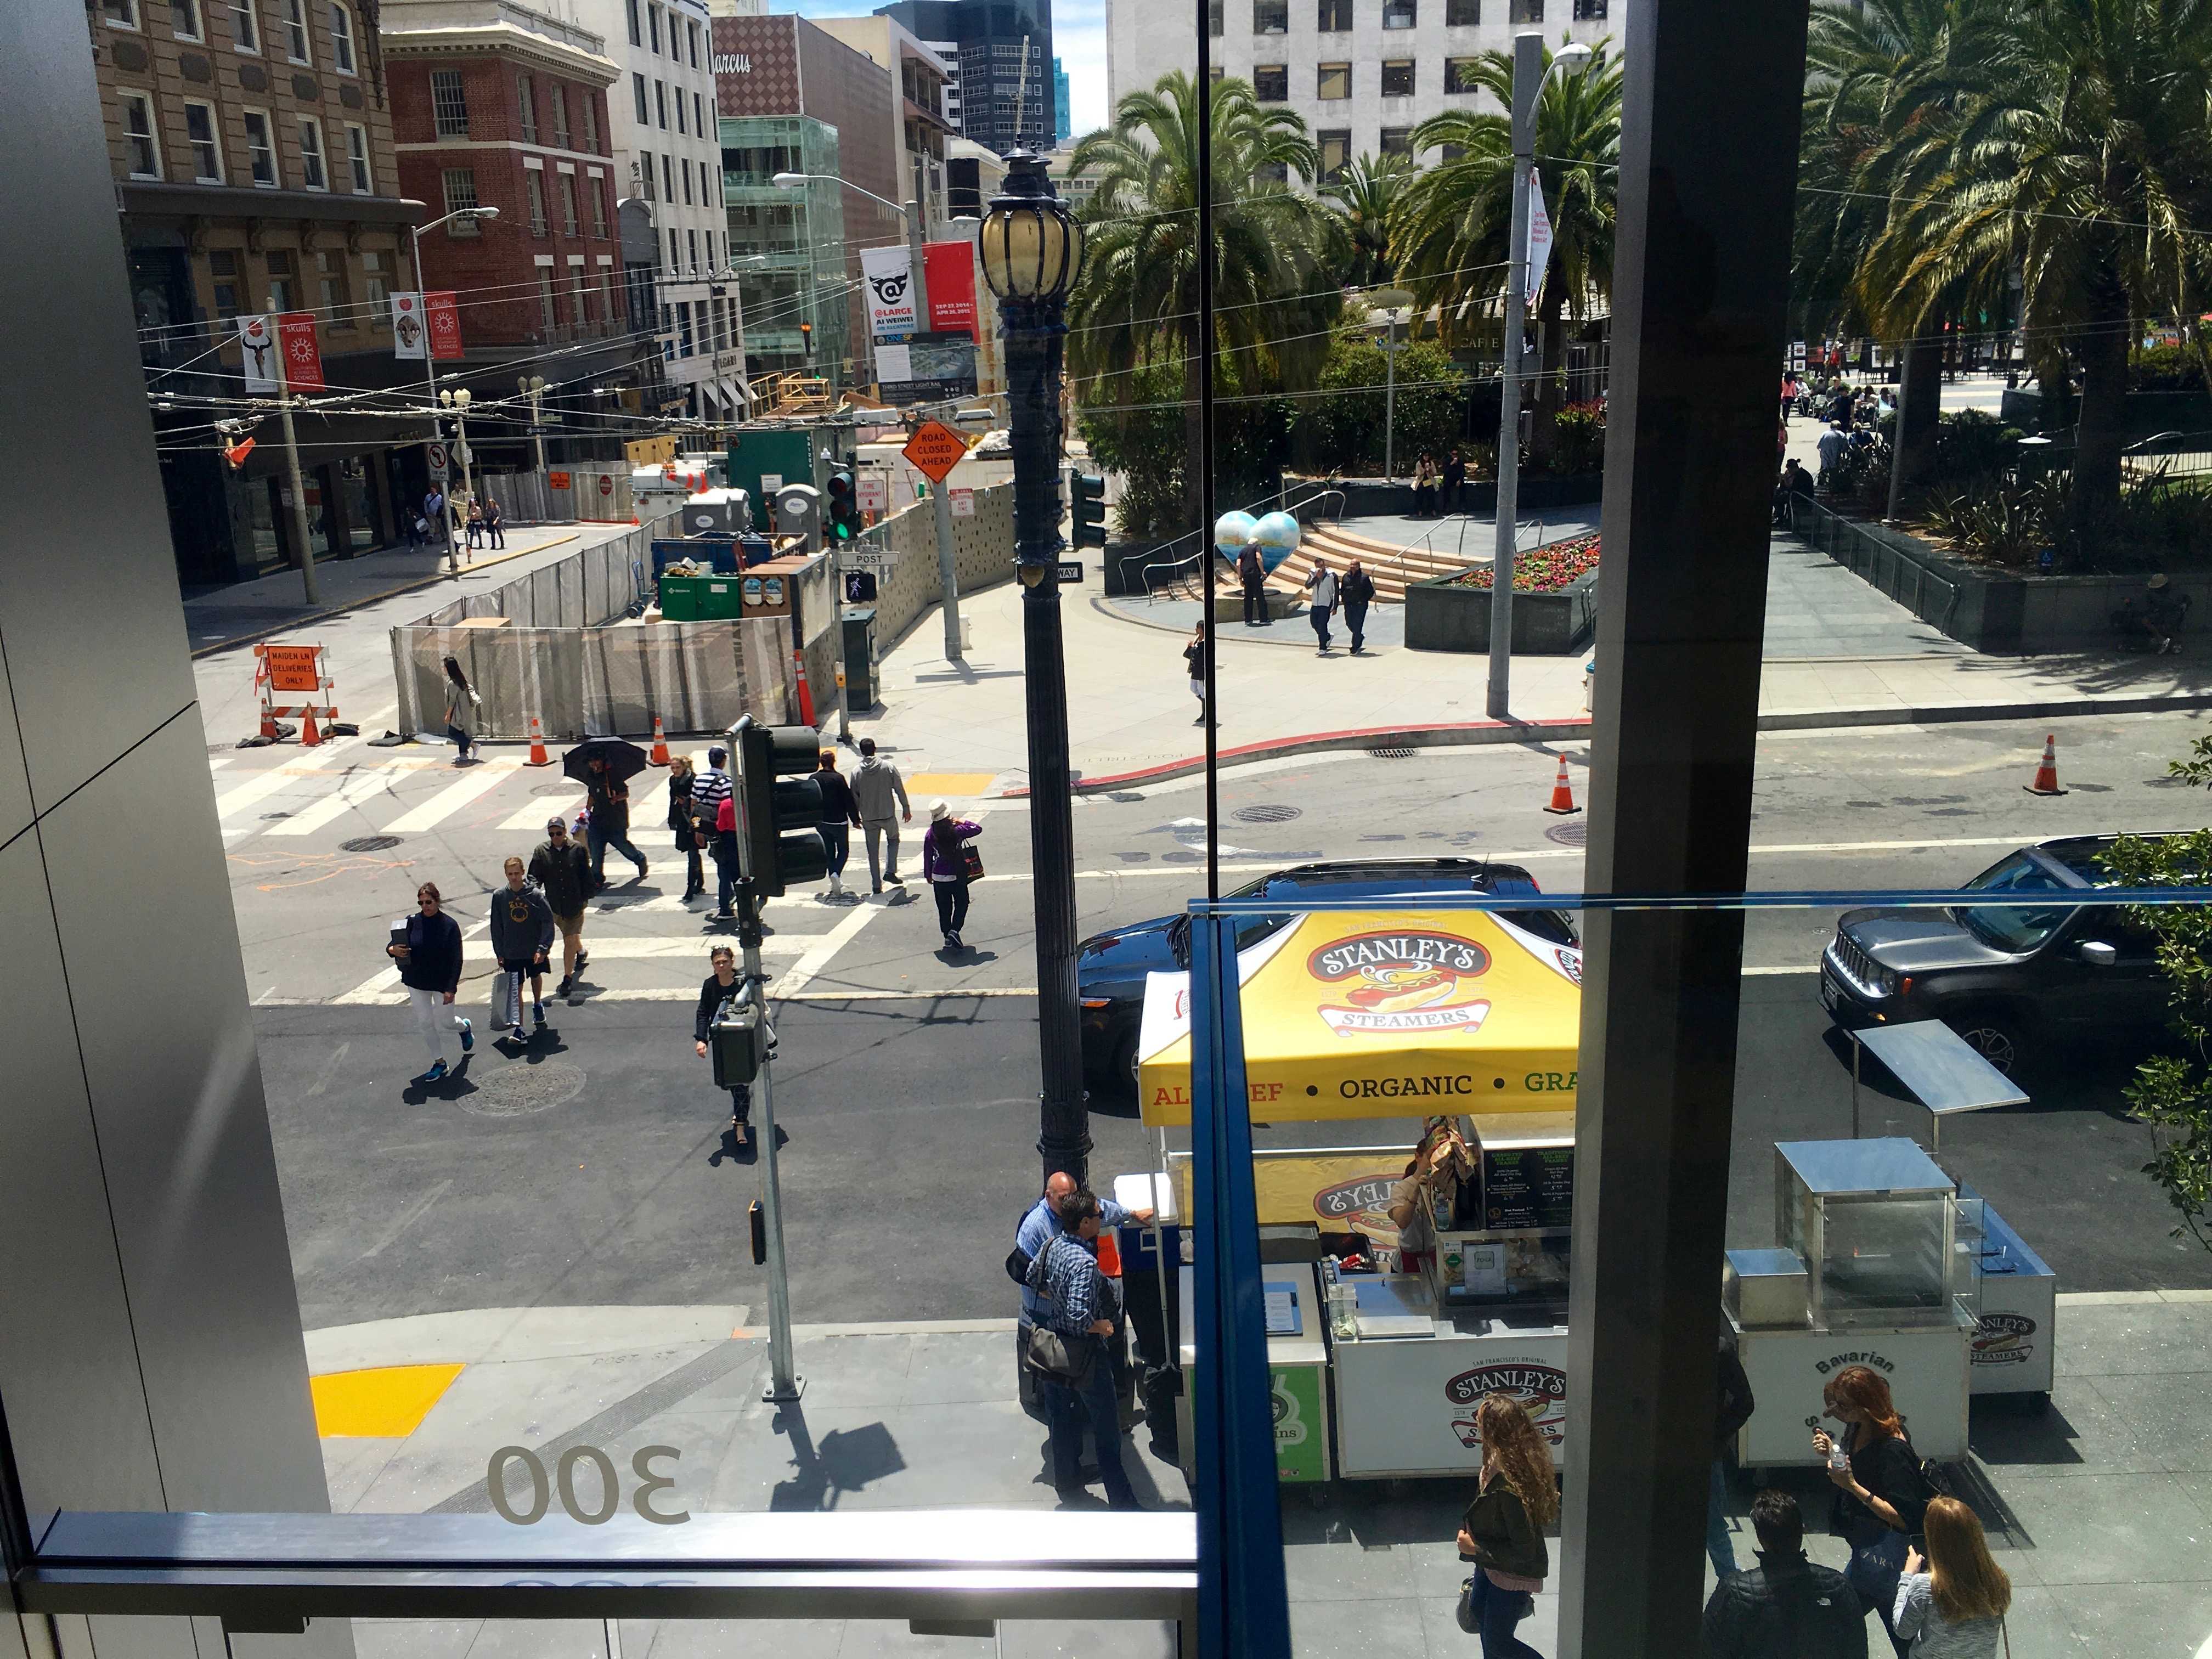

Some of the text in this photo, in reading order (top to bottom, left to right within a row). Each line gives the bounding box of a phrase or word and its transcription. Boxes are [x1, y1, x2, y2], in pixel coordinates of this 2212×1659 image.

[715, 54, 753, 74] arcus
[431, 299, 453, 308] skulls
[874, 307, 913, 318] @LARGE
[286, 324, 311, 332] skulls
[922, 433, 946, 442] ROAD
[918, 445, 951, 454] CLOSED
[922, 457, 951, 466] AHEAD
[856, 555, 882, 563] POST
[274, 664, 312, 673] DELIVERIES
[1322, 938, 1475, 974] STANLEY'S
[1342, 1009, 1470, 1027] STEAMERS
[1340, 1075, 1472, 1098] ORGANIC
[1815, 1351, 1895, 1374] Bavarian
[1456, 1371, 1565, 1398] STANLEY'S
